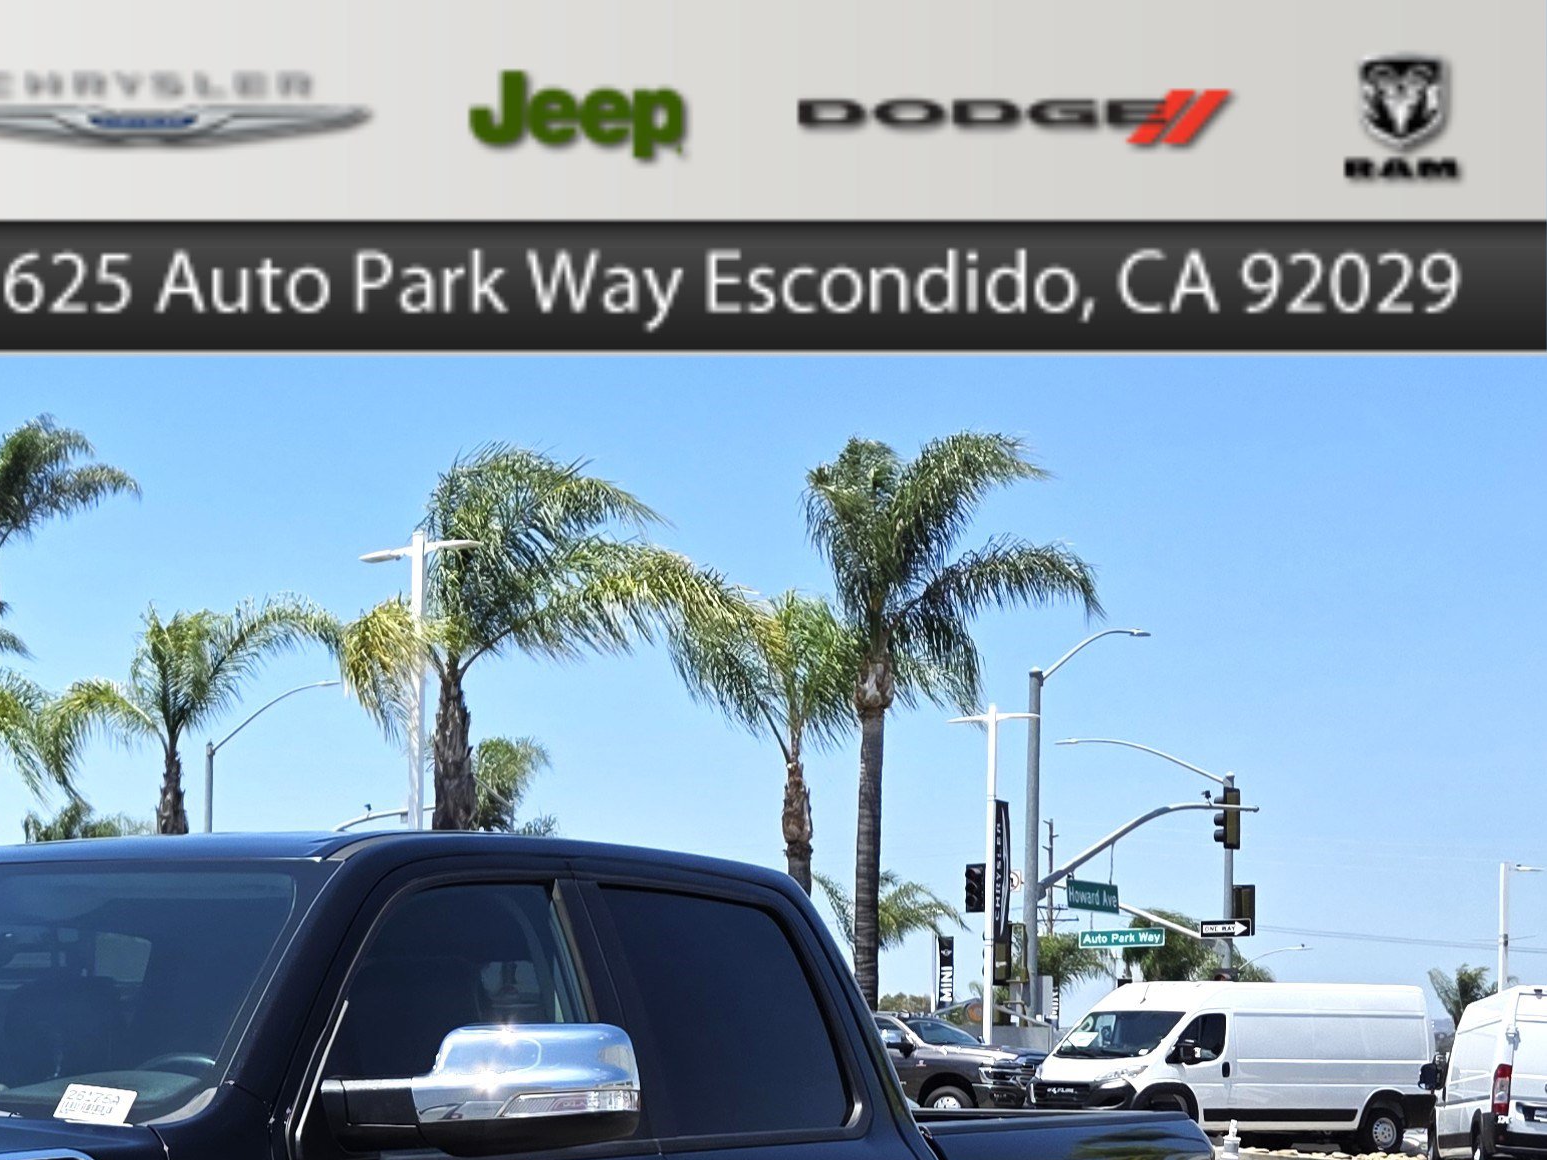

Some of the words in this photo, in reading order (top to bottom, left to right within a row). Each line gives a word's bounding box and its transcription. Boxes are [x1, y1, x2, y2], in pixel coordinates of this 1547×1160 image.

[994, 822, 1002, 921] CHRYSLER
[1068, 886, 1100, 906] Howard
[1103, 891, 1118, 908] Ave
[1082, 933, 1108, 944] Auto
[1111, 932, 1135, 943] Park
[1139, 932, 1161, 944] Way
[939, 966, 953, 1002] MINI
